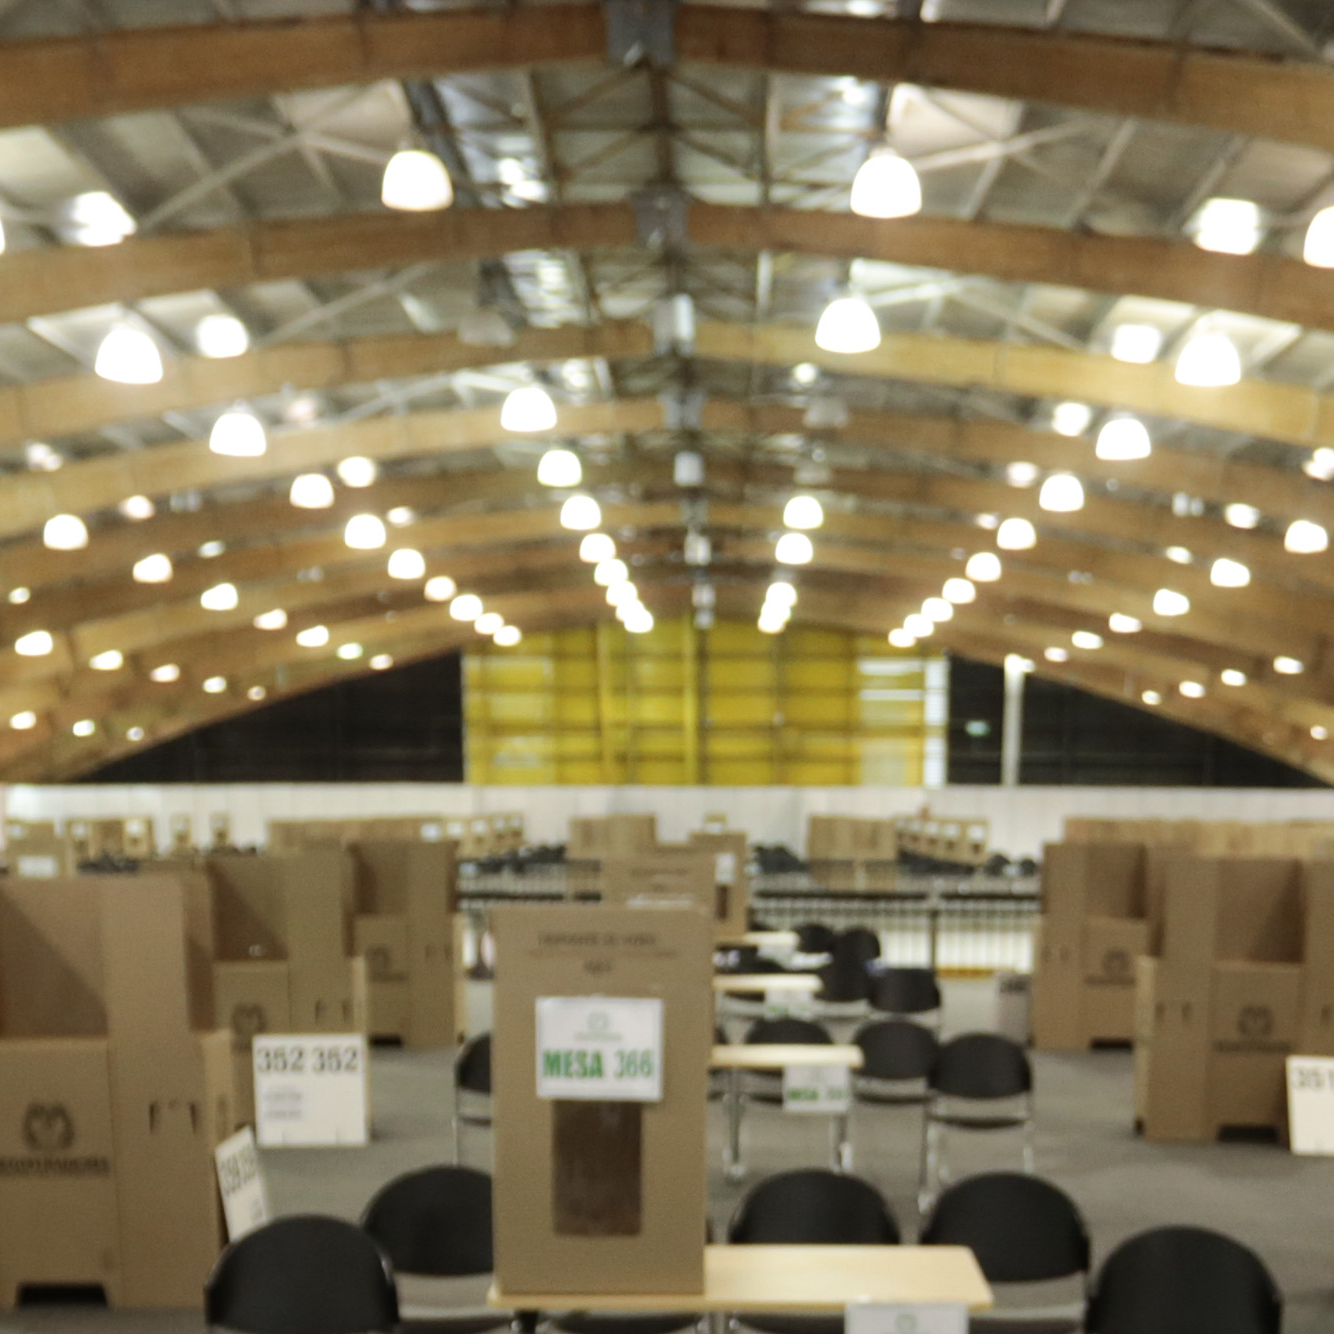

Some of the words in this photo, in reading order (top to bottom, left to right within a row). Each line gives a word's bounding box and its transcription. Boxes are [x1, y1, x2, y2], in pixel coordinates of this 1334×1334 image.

[257, 1046, 304, 1073] 352
[312, 1045, 358, 1073] 352
[542, 1050, 603, 1078] MESA
